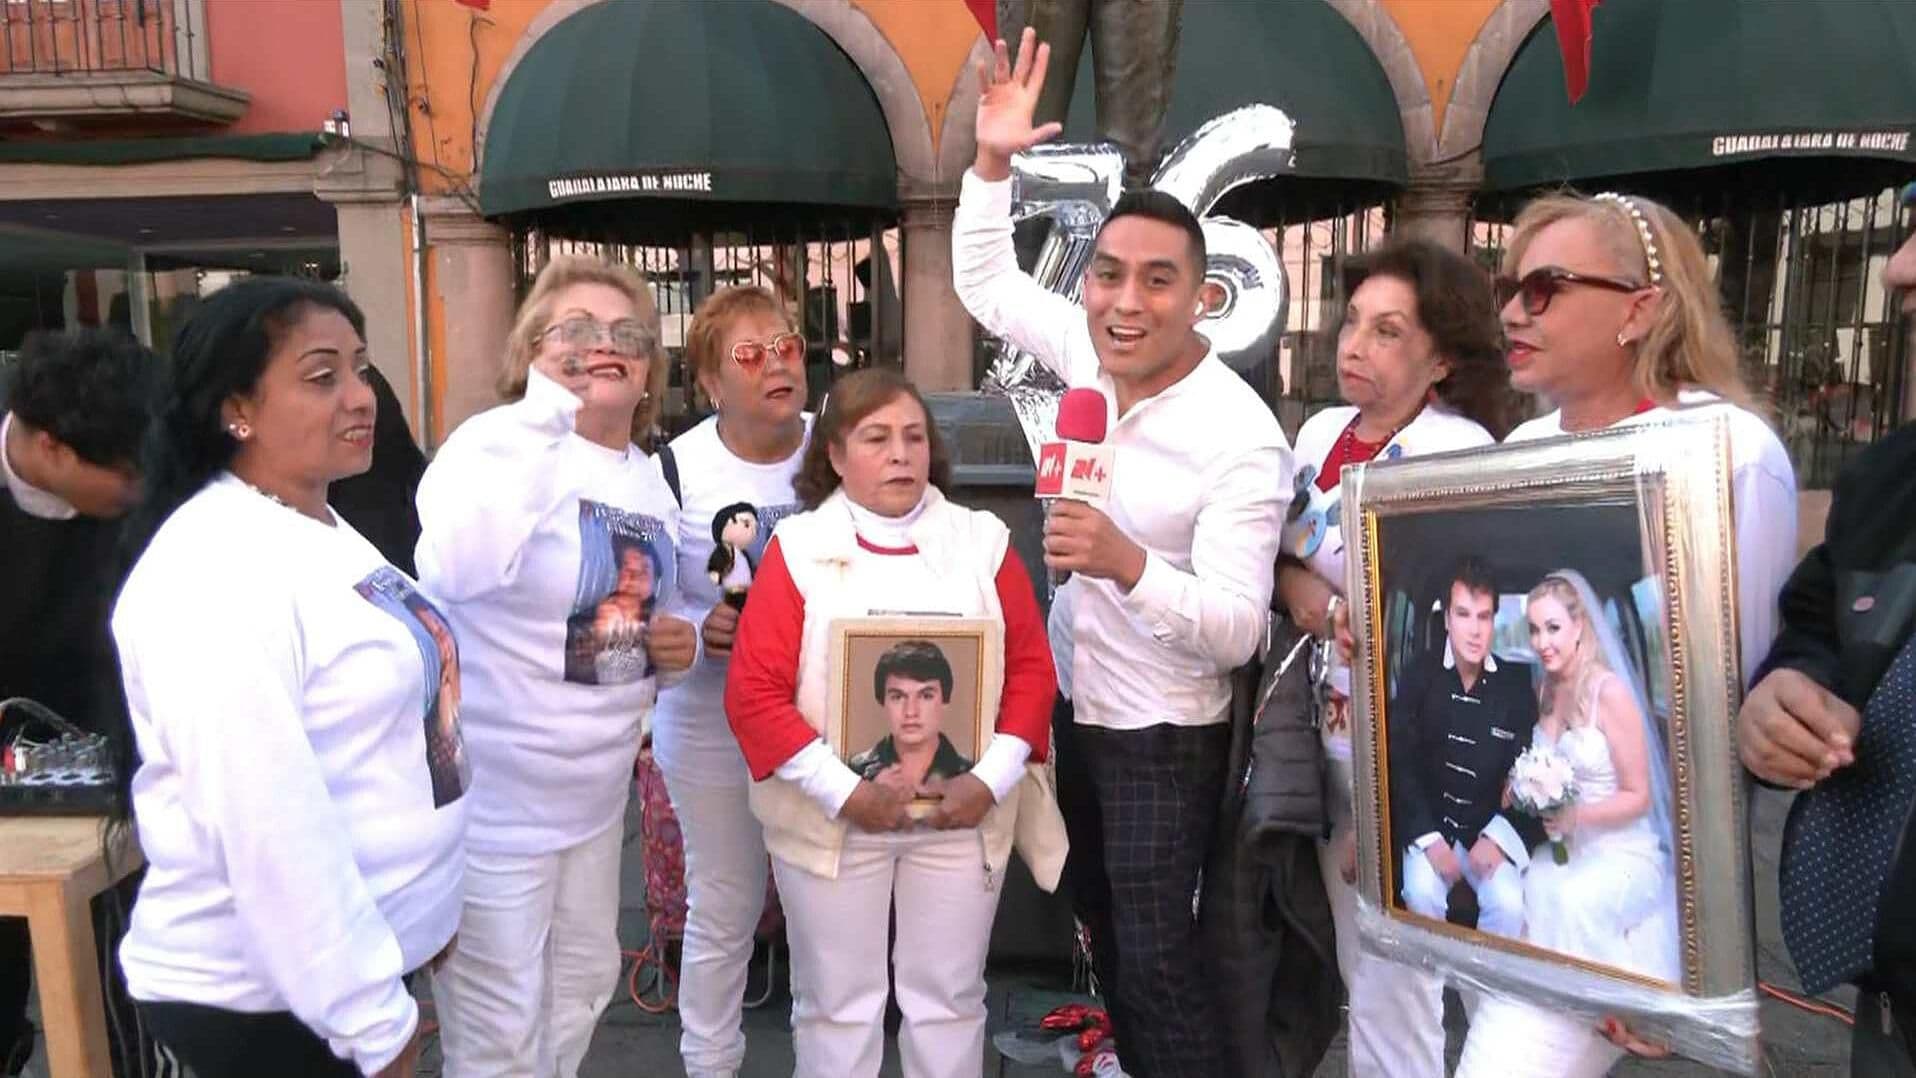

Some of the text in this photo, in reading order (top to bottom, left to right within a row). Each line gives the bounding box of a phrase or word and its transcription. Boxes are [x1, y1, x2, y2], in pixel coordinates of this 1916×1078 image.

[1712, 133, 1833, 156] GUADALAJARA
[1859, 132, 1910, 151] NOCHE
[548, 175, 639, 198] GUADALAJARA
[662, 173, 712, 191] NOCHE
